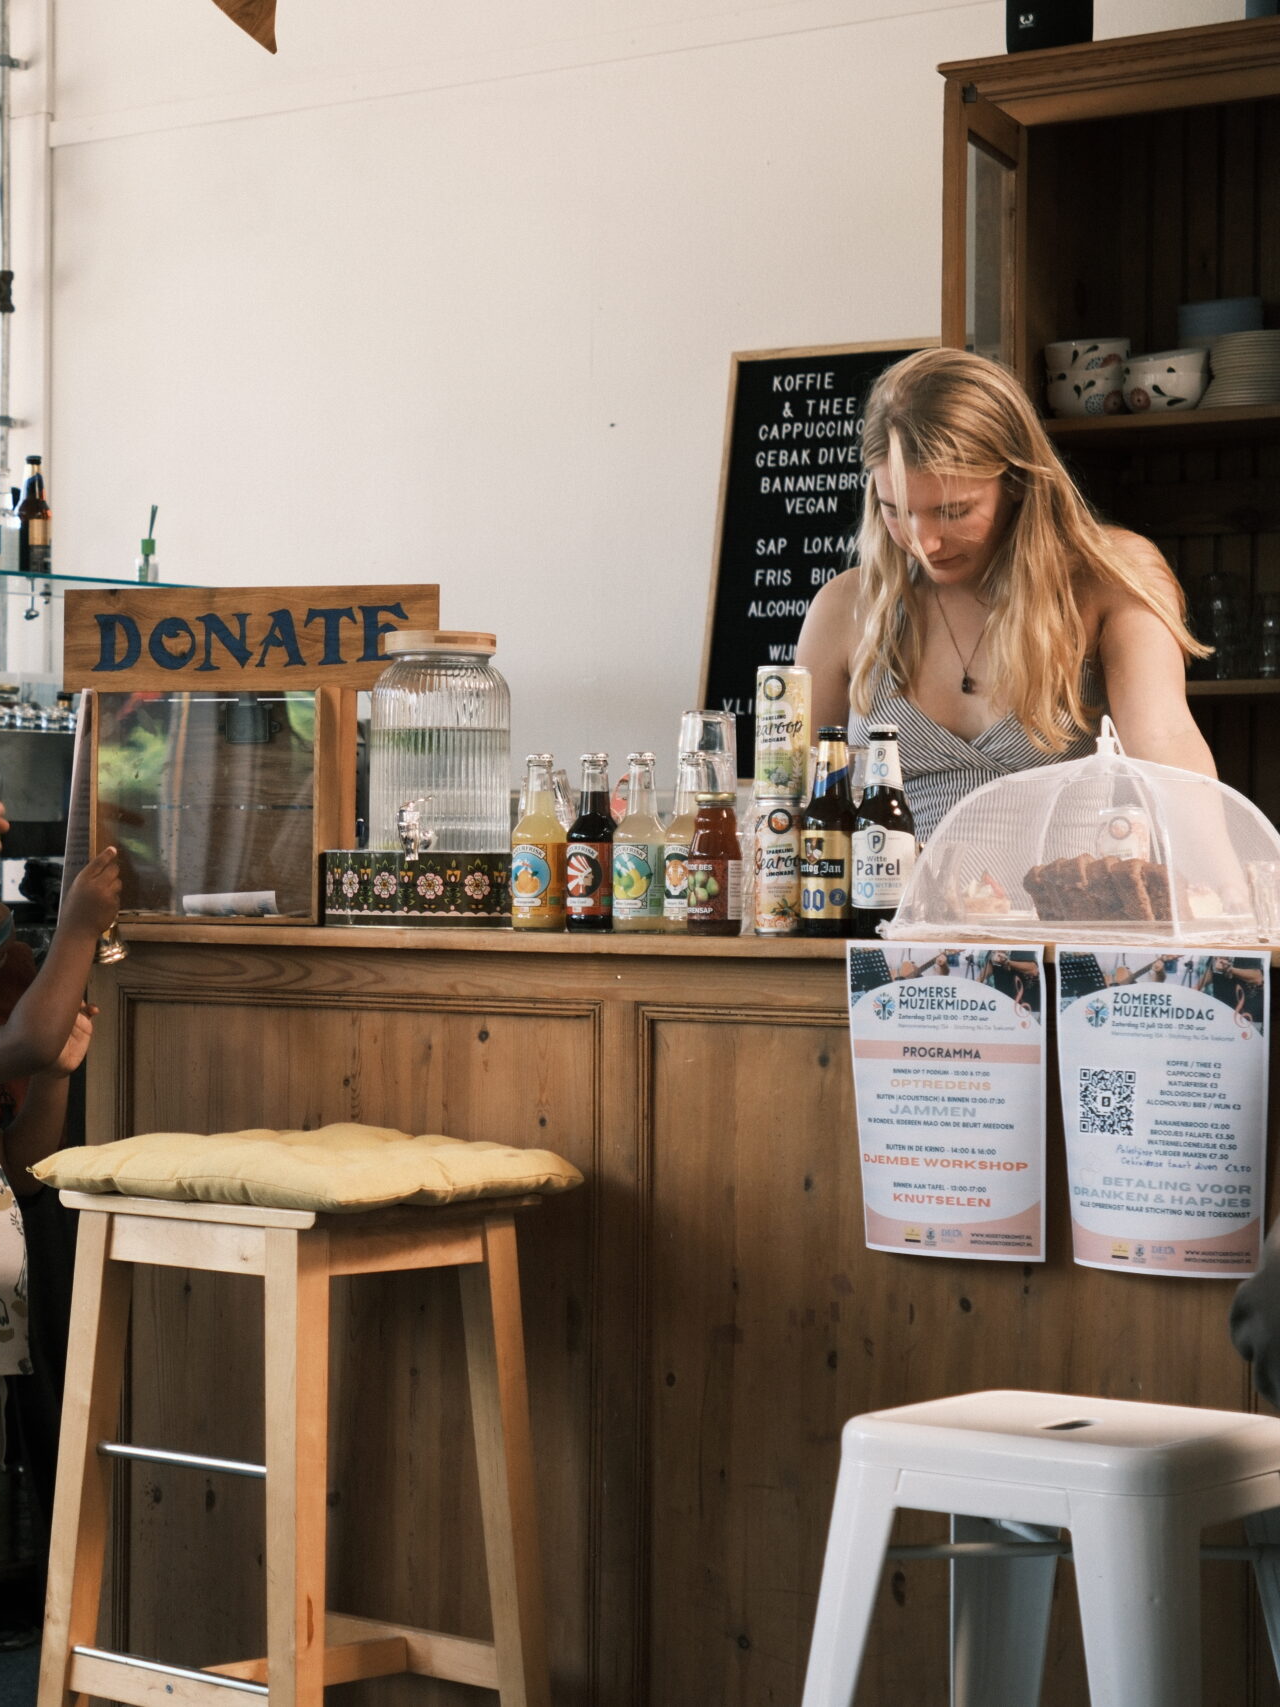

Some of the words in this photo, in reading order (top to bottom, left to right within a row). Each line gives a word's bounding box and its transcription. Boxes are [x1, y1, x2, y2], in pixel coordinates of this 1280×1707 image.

[772, 372, 835, 392] KOFFIE
[782, 401, 794, 418] &
[806, 397, 857, 416] THEE
[758, 419, 865, 441] CAPPUCCINO
[755, 449, 811, 468] GEBAK
[818, 446, 864, 465] DIVE
[785, 497, 838, 514] VEGAN
[756, 538, 787, 555] SAP
[754, 569, 792, 587] FRIS
[810, 567, 836, 585] BIO
[91, 602, 409, 672] DONATE
[820, 862, 841, 876] Jan
[856, 858, 900, 876] Parel
[899, 986, 957, 998] ZOMERSE
[1113, 992, 1172, 1006] ZOMERSE
[899, 999, 997, 1011] MUZIEKMIDDAG
[1112, 1006, 1214, 1020] MUZIEKMIDDAG
[902, 1047, 981, 1059] PROGRAMMA
[1166, 1070, 1211, 1078] CAPPUCCINO
[890, 1079, 992, 1091] OPTREDENS
[889, 1104, 977, 1117] JAMMEN
[1154, 1120, 1208, 1128] BANANENBROOD
[1150, 1129, 1183, 1137] BROODJES
[1185, 1131, 1213, 1139] FALAFEL
[1154, 1149, 1181, 1157] VLIEGER
[863, 1154, 919, 1166] DJEMBE
[924, 1158, 1028, 1172] WORKSHOP
[1102, 1176, 1191, 1192] BETALING
[1196, 1183, 1252, 1195] VOOR
[893, 1193, 992, 1208] KNUTSELEN
[1073, 1186, 1149, 1203] DRANKEN
[1153, 1194, 1166, 1204] &
[1170, 1195, 1251, 1208] HAPJES
[1126, 1205, 1144, 1213] NAAR
[1145, 1207, 1183, 1216] STICHTING
[1184, 1209, 1195, 1217] NU
[1208, 1210, 1251, 1218] TOEKOMST
